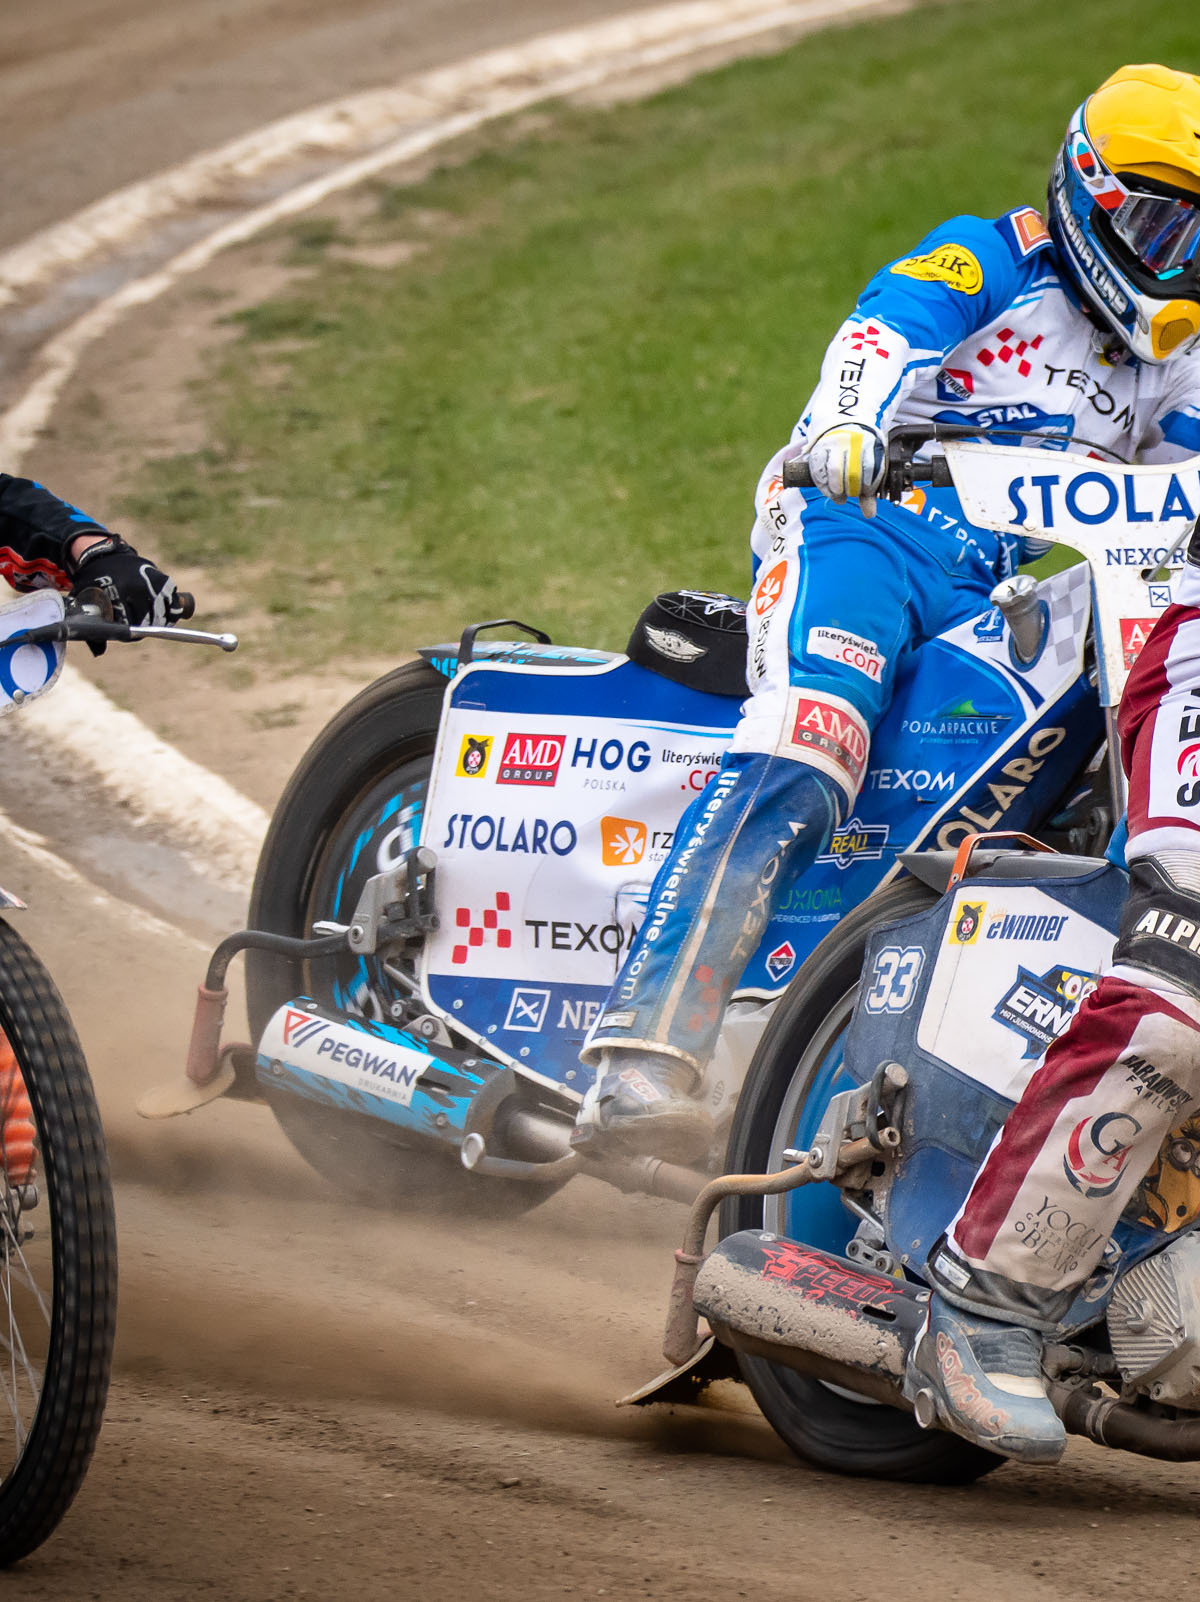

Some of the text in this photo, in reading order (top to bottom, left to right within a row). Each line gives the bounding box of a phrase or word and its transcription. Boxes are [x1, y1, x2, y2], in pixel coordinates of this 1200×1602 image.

[976, 404, 1037, 428] STAL
[503, 738, 562, 766] AMD
[800, 705, 866, 763] AMD
[571, 737, 651, 773] HOG
[502, 769, 554, 780] GROUP
[583, 778, 627, 792] POLSKA
[869, 769, 956, 791] TEXOM
[443, 814, 578, 857] STOLARO
[865, 946, 927, 1014] 33
[316, 1037, 417, 1088] PEGWAN
[1125, 1074, 1175, 1114] FAMILY
